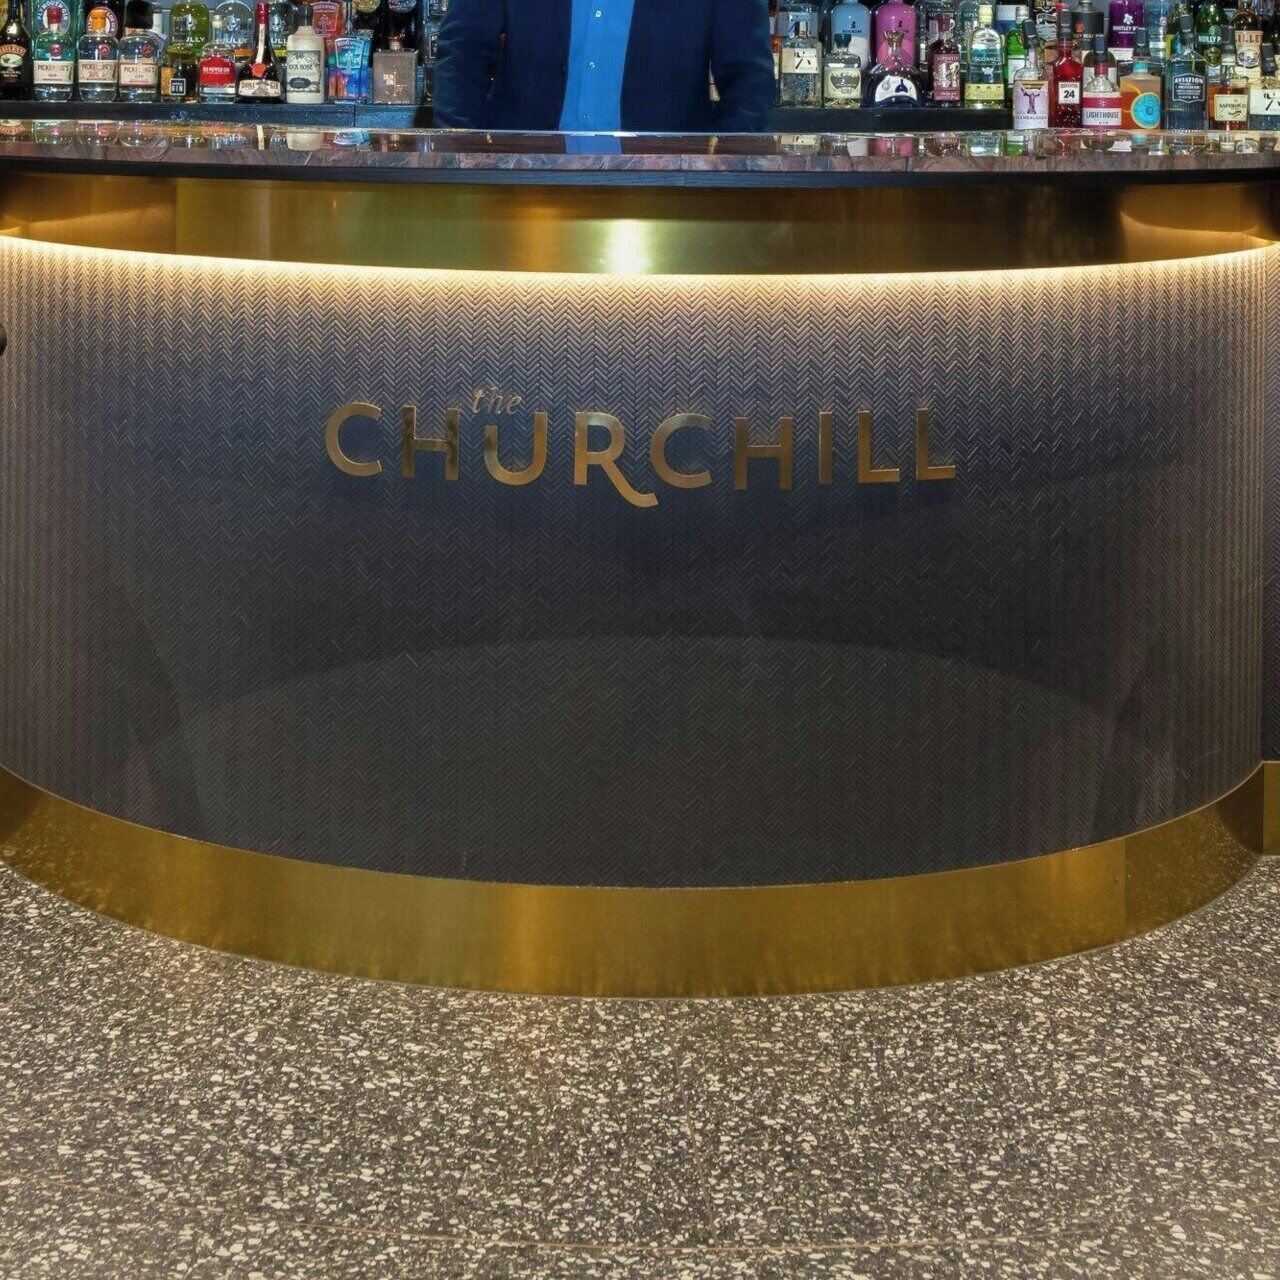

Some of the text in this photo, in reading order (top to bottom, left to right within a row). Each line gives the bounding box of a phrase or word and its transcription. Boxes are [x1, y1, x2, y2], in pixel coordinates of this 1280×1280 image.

[1063, 90, 1075, 99] 24
[470, 385, 522, 416] the
[324, 401, 958, 509] CHURCHILL
